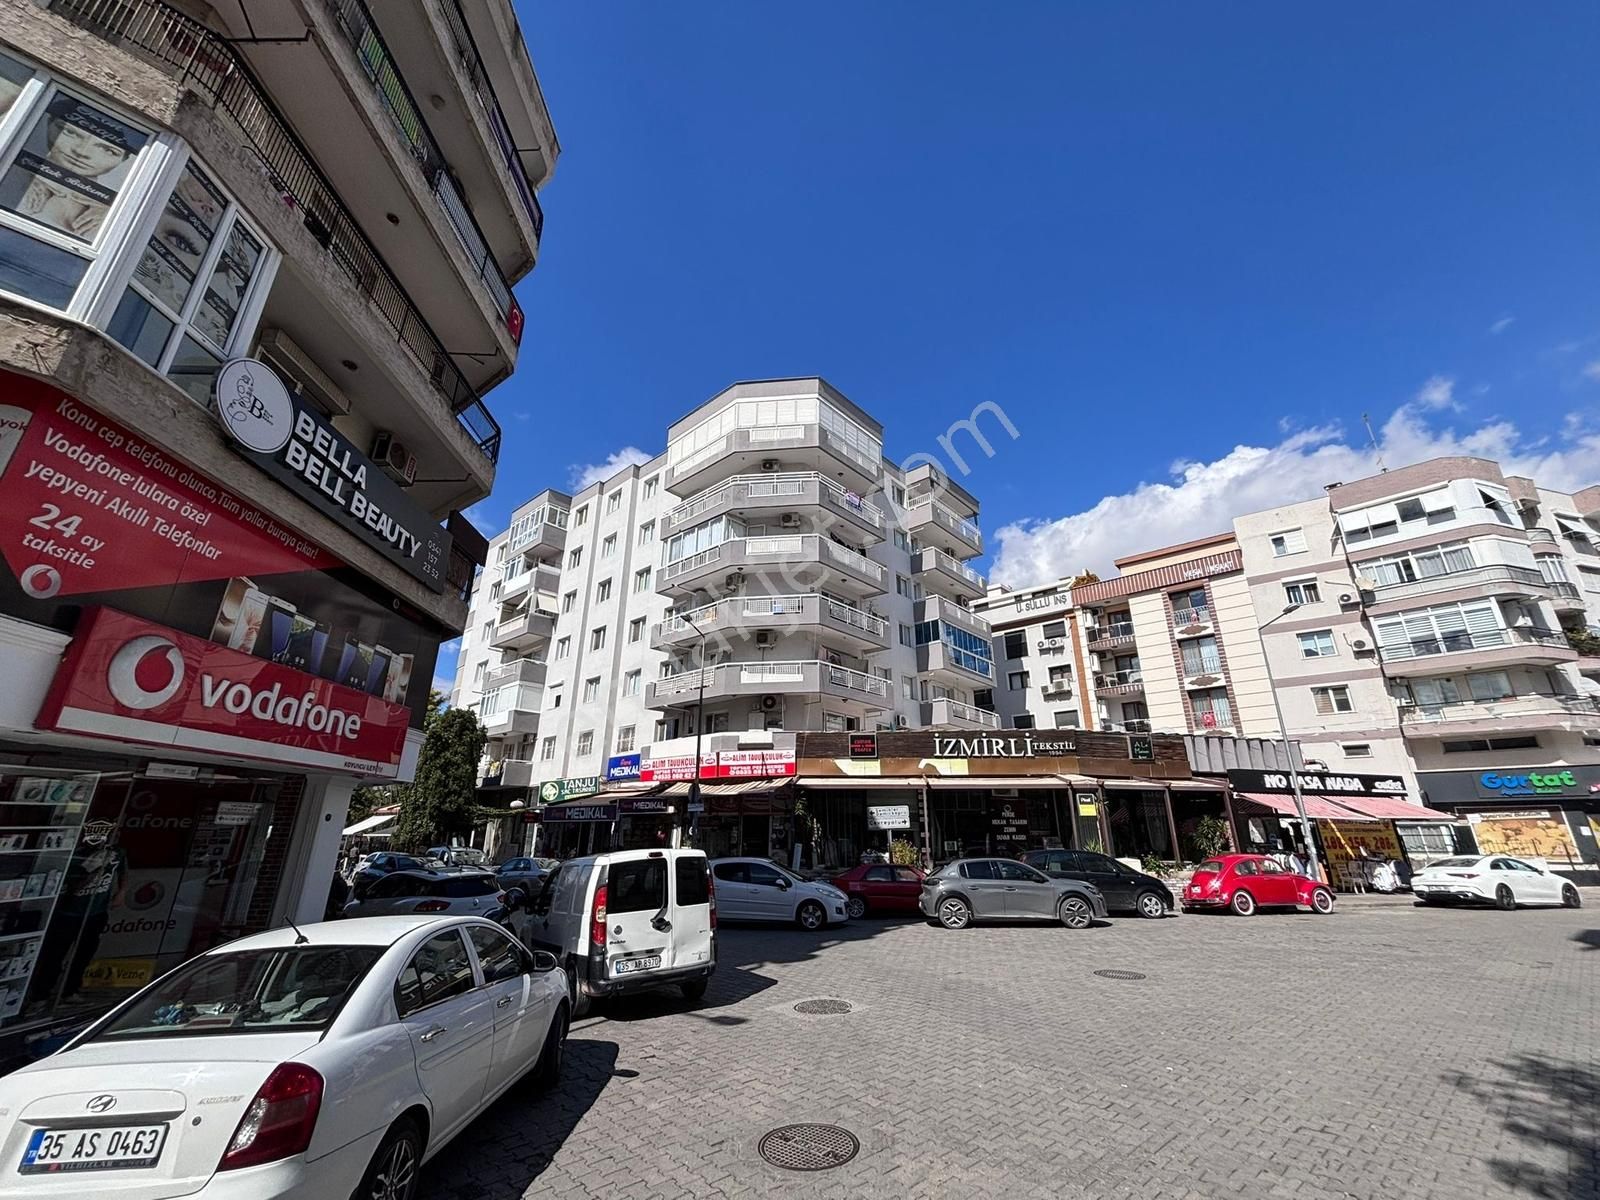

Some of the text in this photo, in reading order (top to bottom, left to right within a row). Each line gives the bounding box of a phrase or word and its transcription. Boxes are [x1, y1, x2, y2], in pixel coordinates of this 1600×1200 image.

[295, 410, 366, 490] BELLA
[56, 399, 319, 559] Konu cep telefonu olunca, Tüm yollar buraya çıkar!
[285, 438, 421, 558] BELL BEAUTY
[24, 460, 222, 560] yepyeni Akıllı Telefonlar
[29, 503, 105, 552] 24 ay
[180, 502, 212, 527] özel
[22, 533, 95, 569] taksitle
[201, 674, 361, 740] vodafone
[933, 733, 1076, 757] İZMİRLİ TEKSTİL
[563, 778, 595, 789] TANJU
[1264, 775, 1365, 791] NO ASA NADA
[38, 1130, 158, 1160] 35 AS 0463
